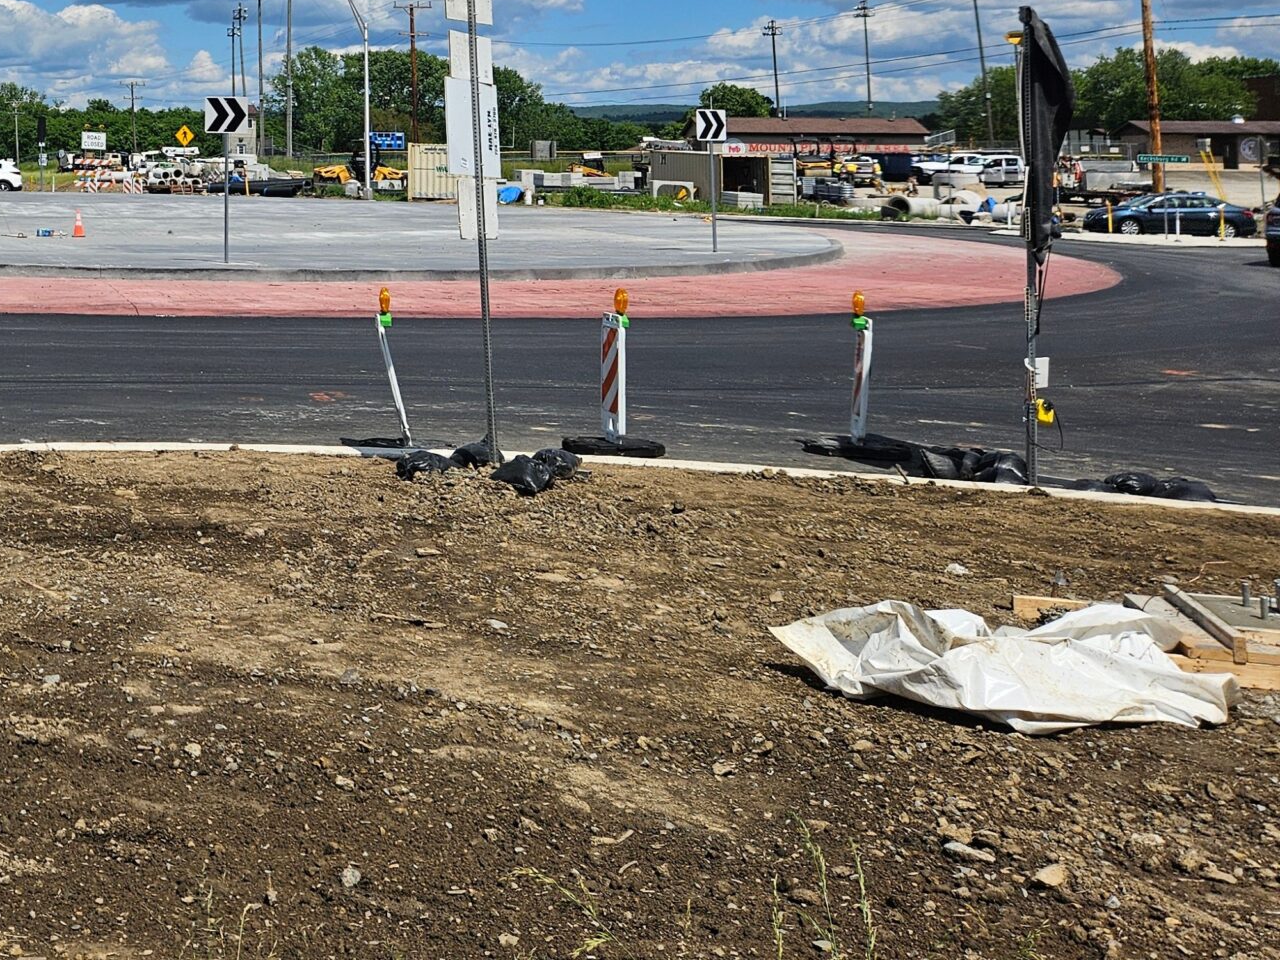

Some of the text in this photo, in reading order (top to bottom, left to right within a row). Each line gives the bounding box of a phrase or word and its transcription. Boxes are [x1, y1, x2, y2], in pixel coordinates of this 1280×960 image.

[747, 143, 910, 153] MOUNT PLASAT AREA
